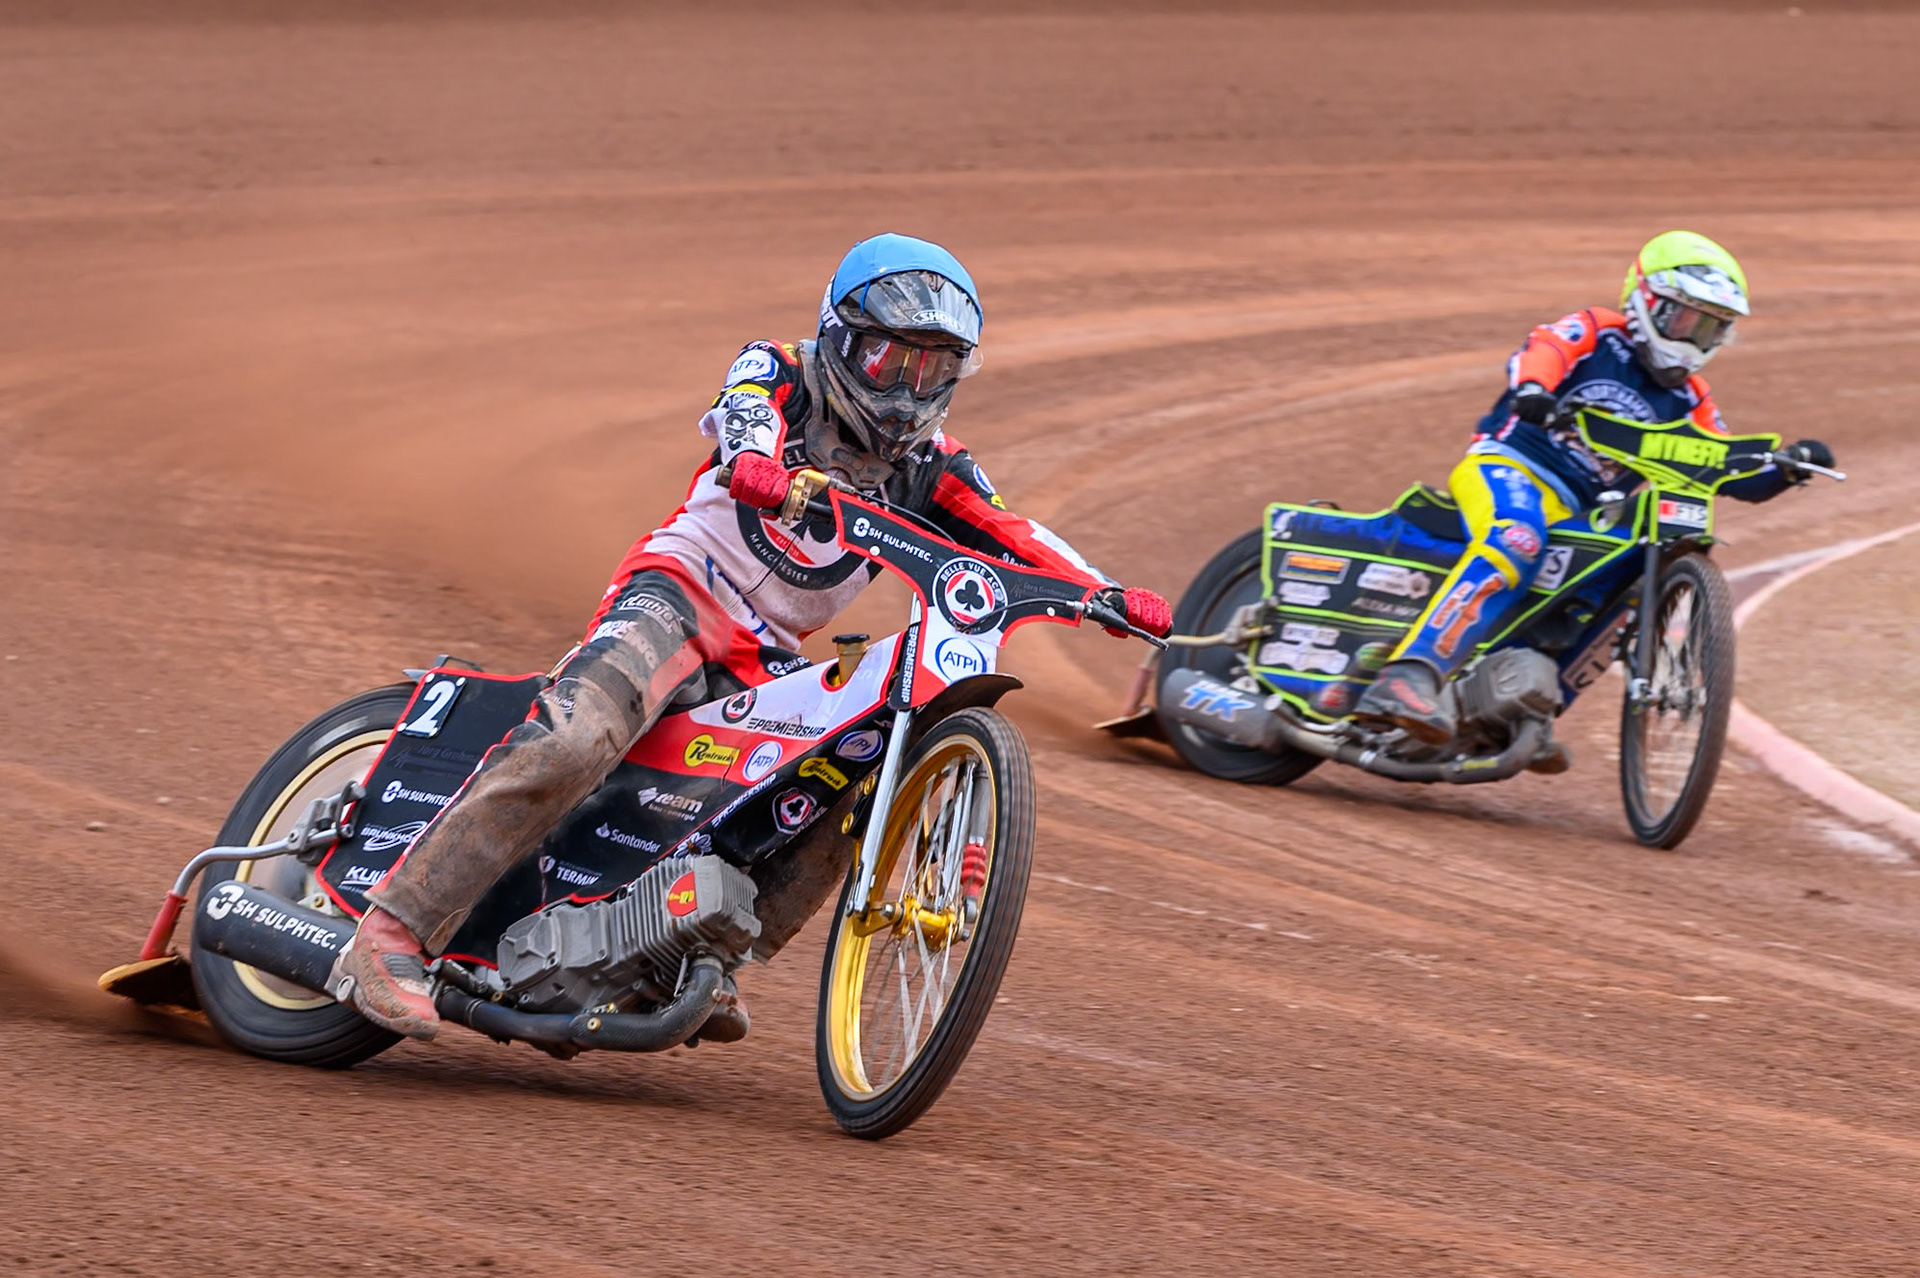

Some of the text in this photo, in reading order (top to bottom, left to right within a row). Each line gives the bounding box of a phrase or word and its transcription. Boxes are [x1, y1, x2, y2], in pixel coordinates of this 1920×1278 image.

[868, 526, 882, 541] SH
[940, 562, 965, 582] BELLE
[968, 564, 986, 579] VUE
[943, 651, 978, 672] ATPI
[405, 680, 455, 737] 2
[610, 829, 661, 853] Santander
[232, 898, 337, 951] SH SULPHTEC.
